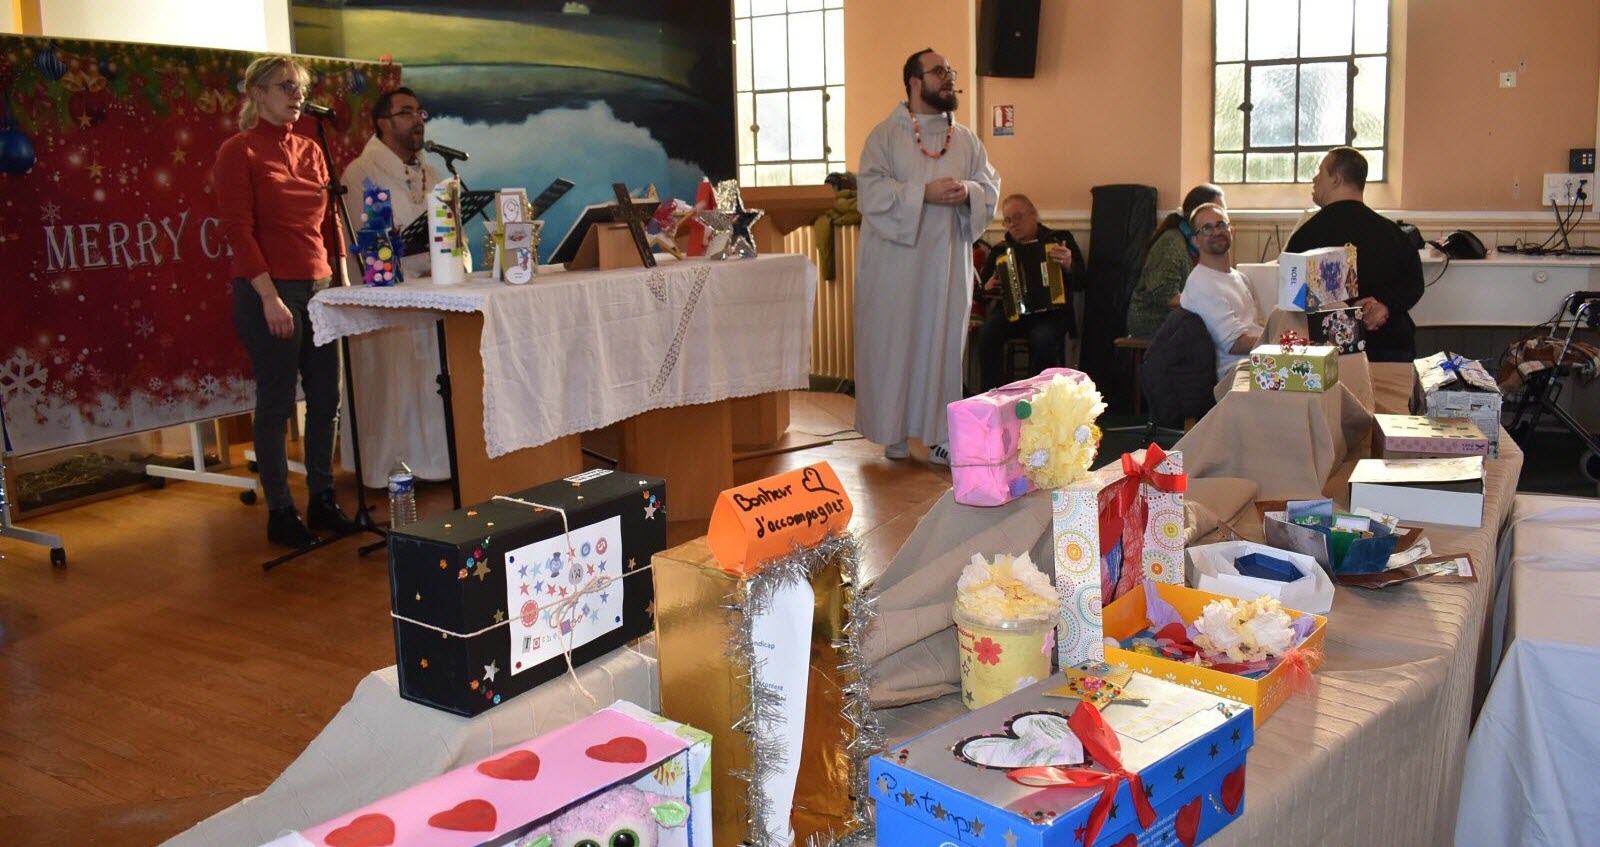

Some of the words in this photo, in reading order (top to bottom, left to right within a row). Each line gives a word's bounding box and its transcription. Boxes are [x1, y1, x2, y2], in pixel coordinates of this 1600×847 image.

[43, 209, 190, 271] MERRY
[200, 217, 234, 258] C
[733, 484, 792, 512] Bonheur
[755, 498, 845, 539] d'accompagner
[877, 772, 981, 841] Prntemp
